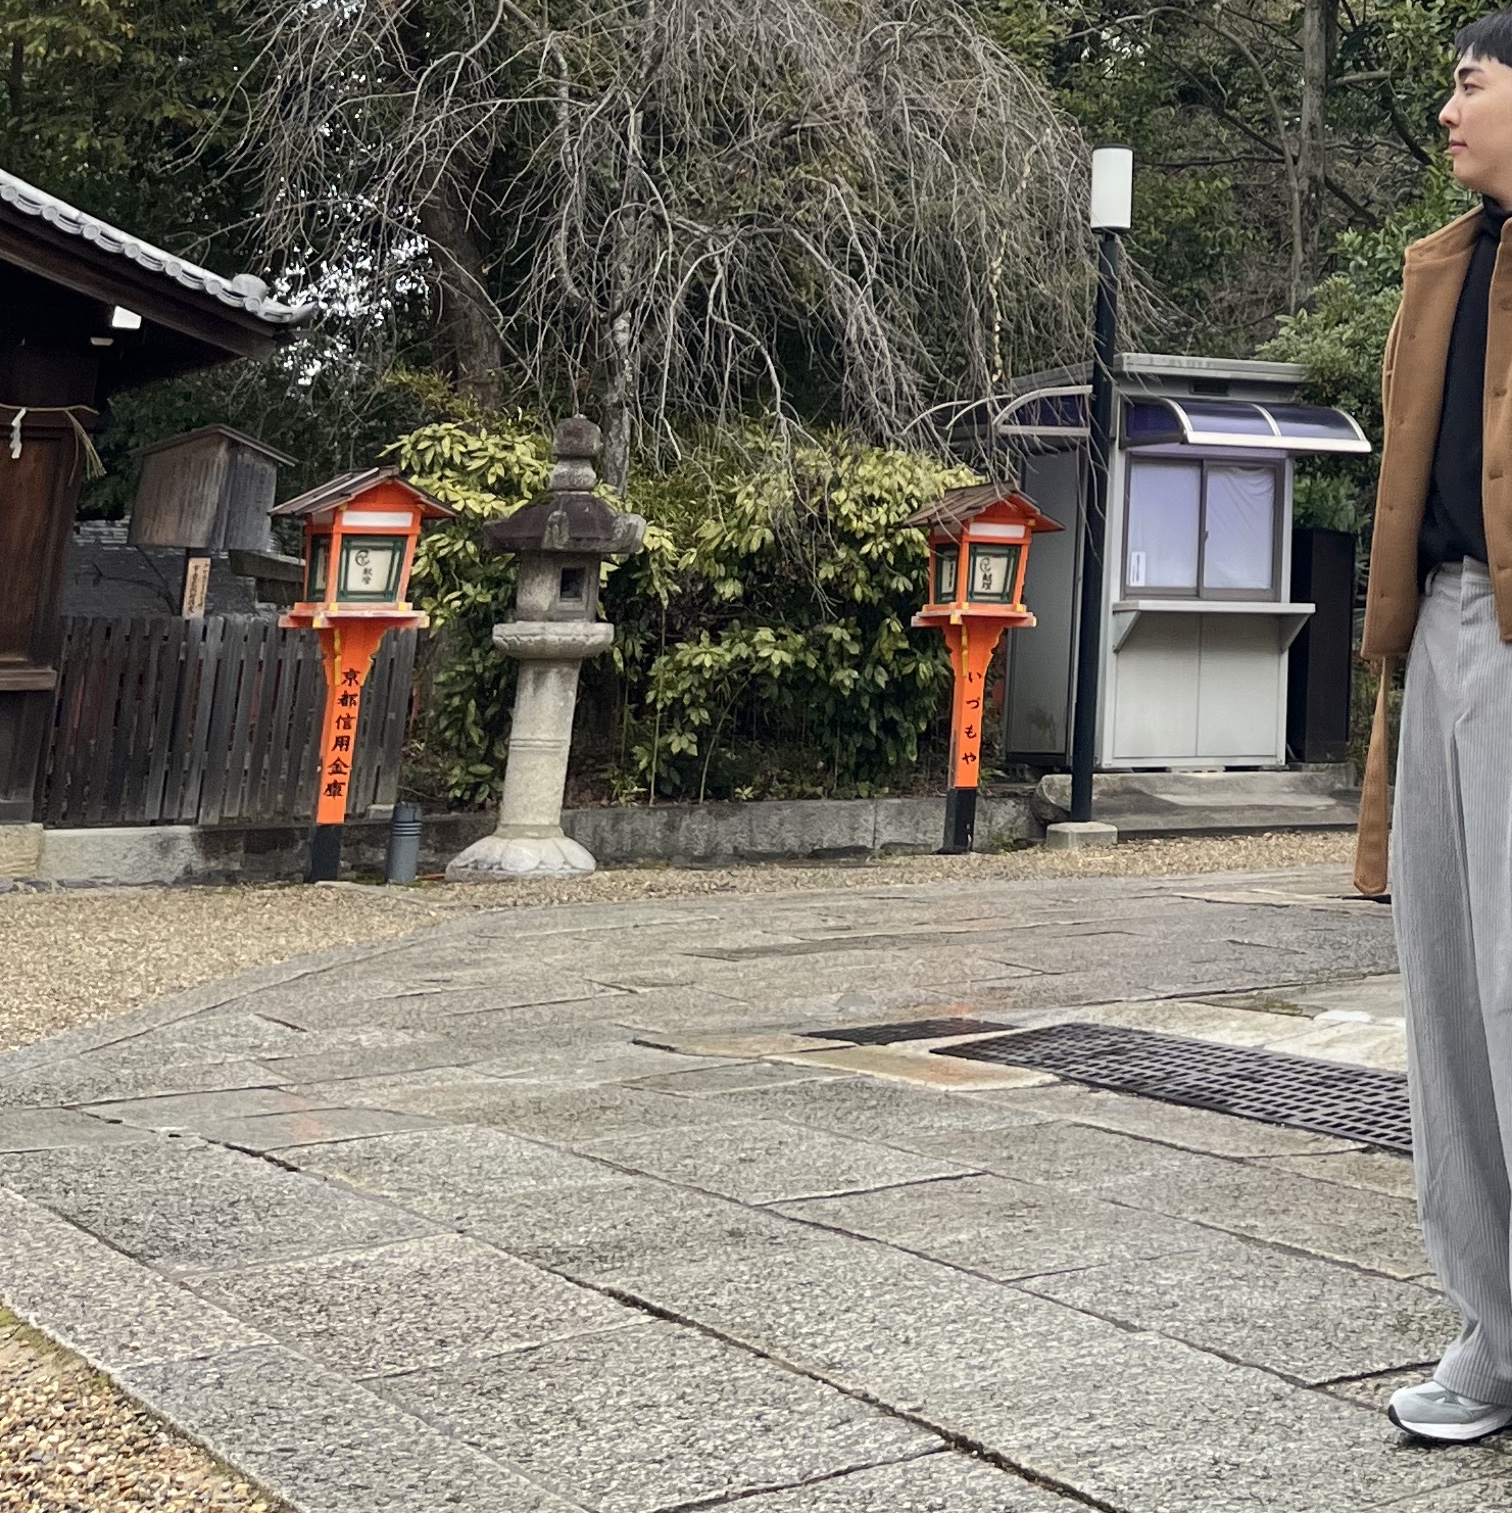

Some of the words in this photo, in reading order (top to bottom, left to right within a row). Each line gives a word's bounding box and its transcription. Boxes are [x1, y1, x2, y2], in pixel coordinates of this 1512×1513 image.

[323, 667, 361, 800] 京都信用金庫
[961, 671, 982, 765] いづもや
